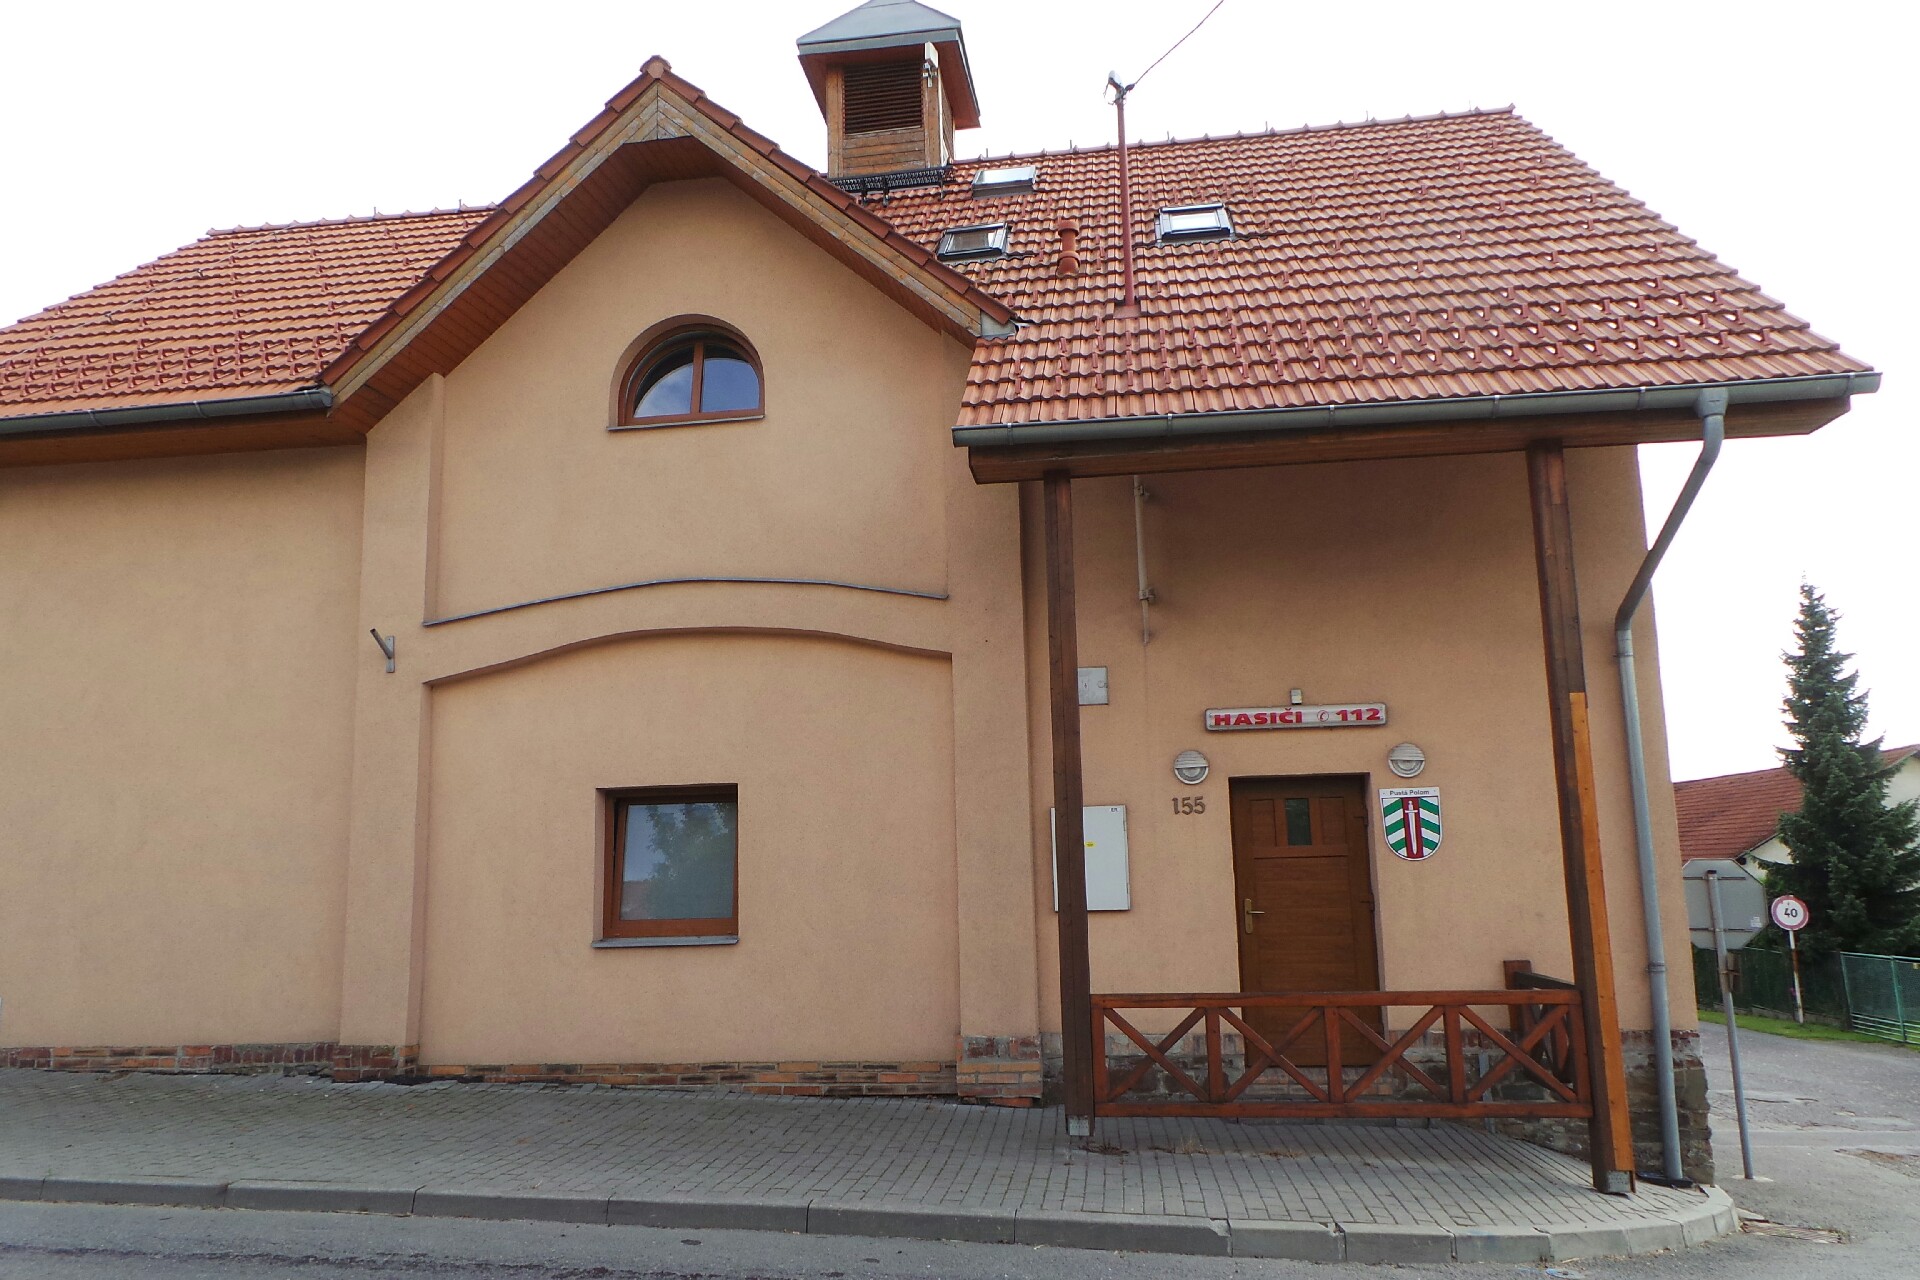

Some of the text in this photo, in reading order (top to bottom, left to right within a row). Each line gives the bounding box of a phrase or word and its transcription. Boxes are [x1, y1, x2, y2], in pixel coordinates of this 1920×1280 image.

[1213, 707, 1381, 726] HASIČI 112
[1172, 796, 1206, 815] 155
[1784, 908, 1798, 918] 40
